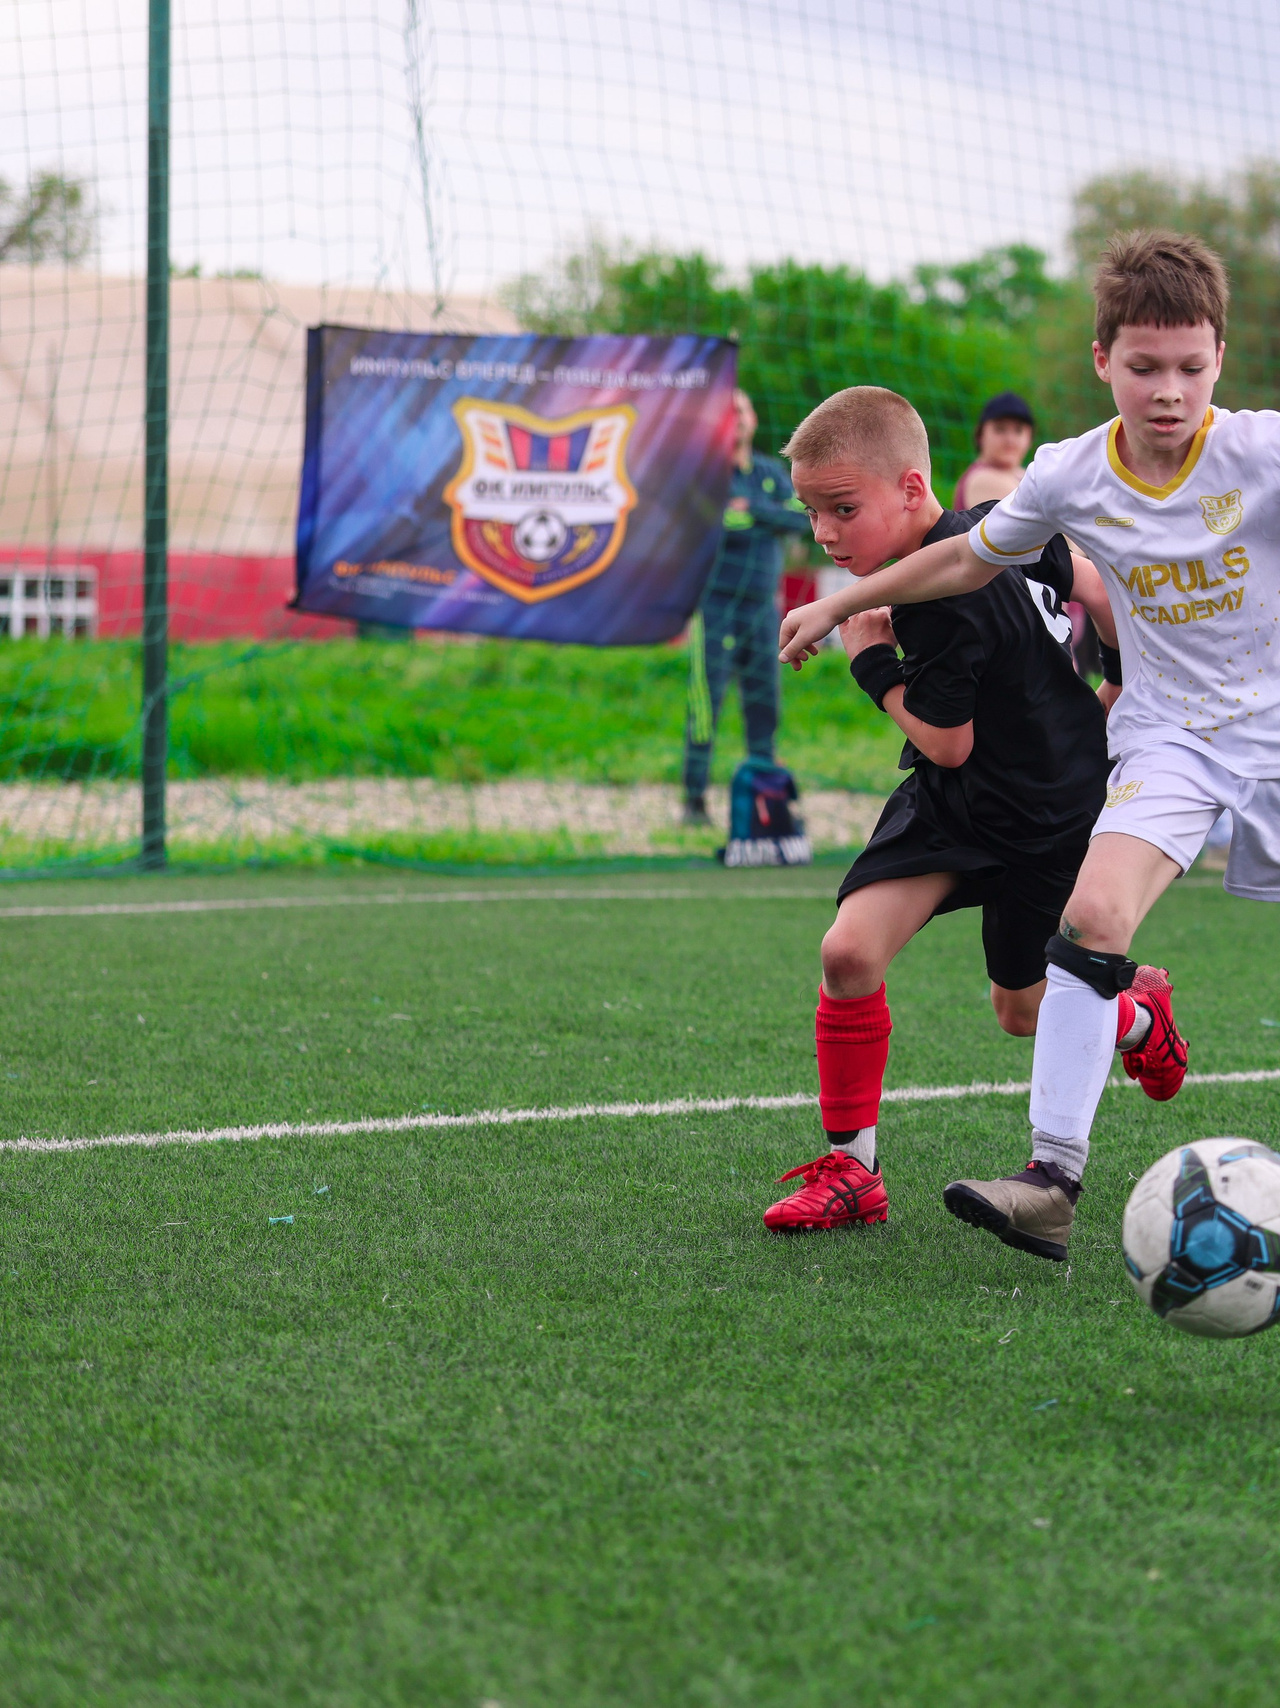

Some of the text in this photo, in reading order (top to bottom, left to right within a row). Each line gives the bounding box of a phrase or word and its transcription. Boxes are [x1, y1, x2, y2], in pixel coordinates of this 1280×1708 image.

[474, 479, 612, 502] ФК ИМПУЛЬС
[1109, 545, 1250, 597] MPULS
